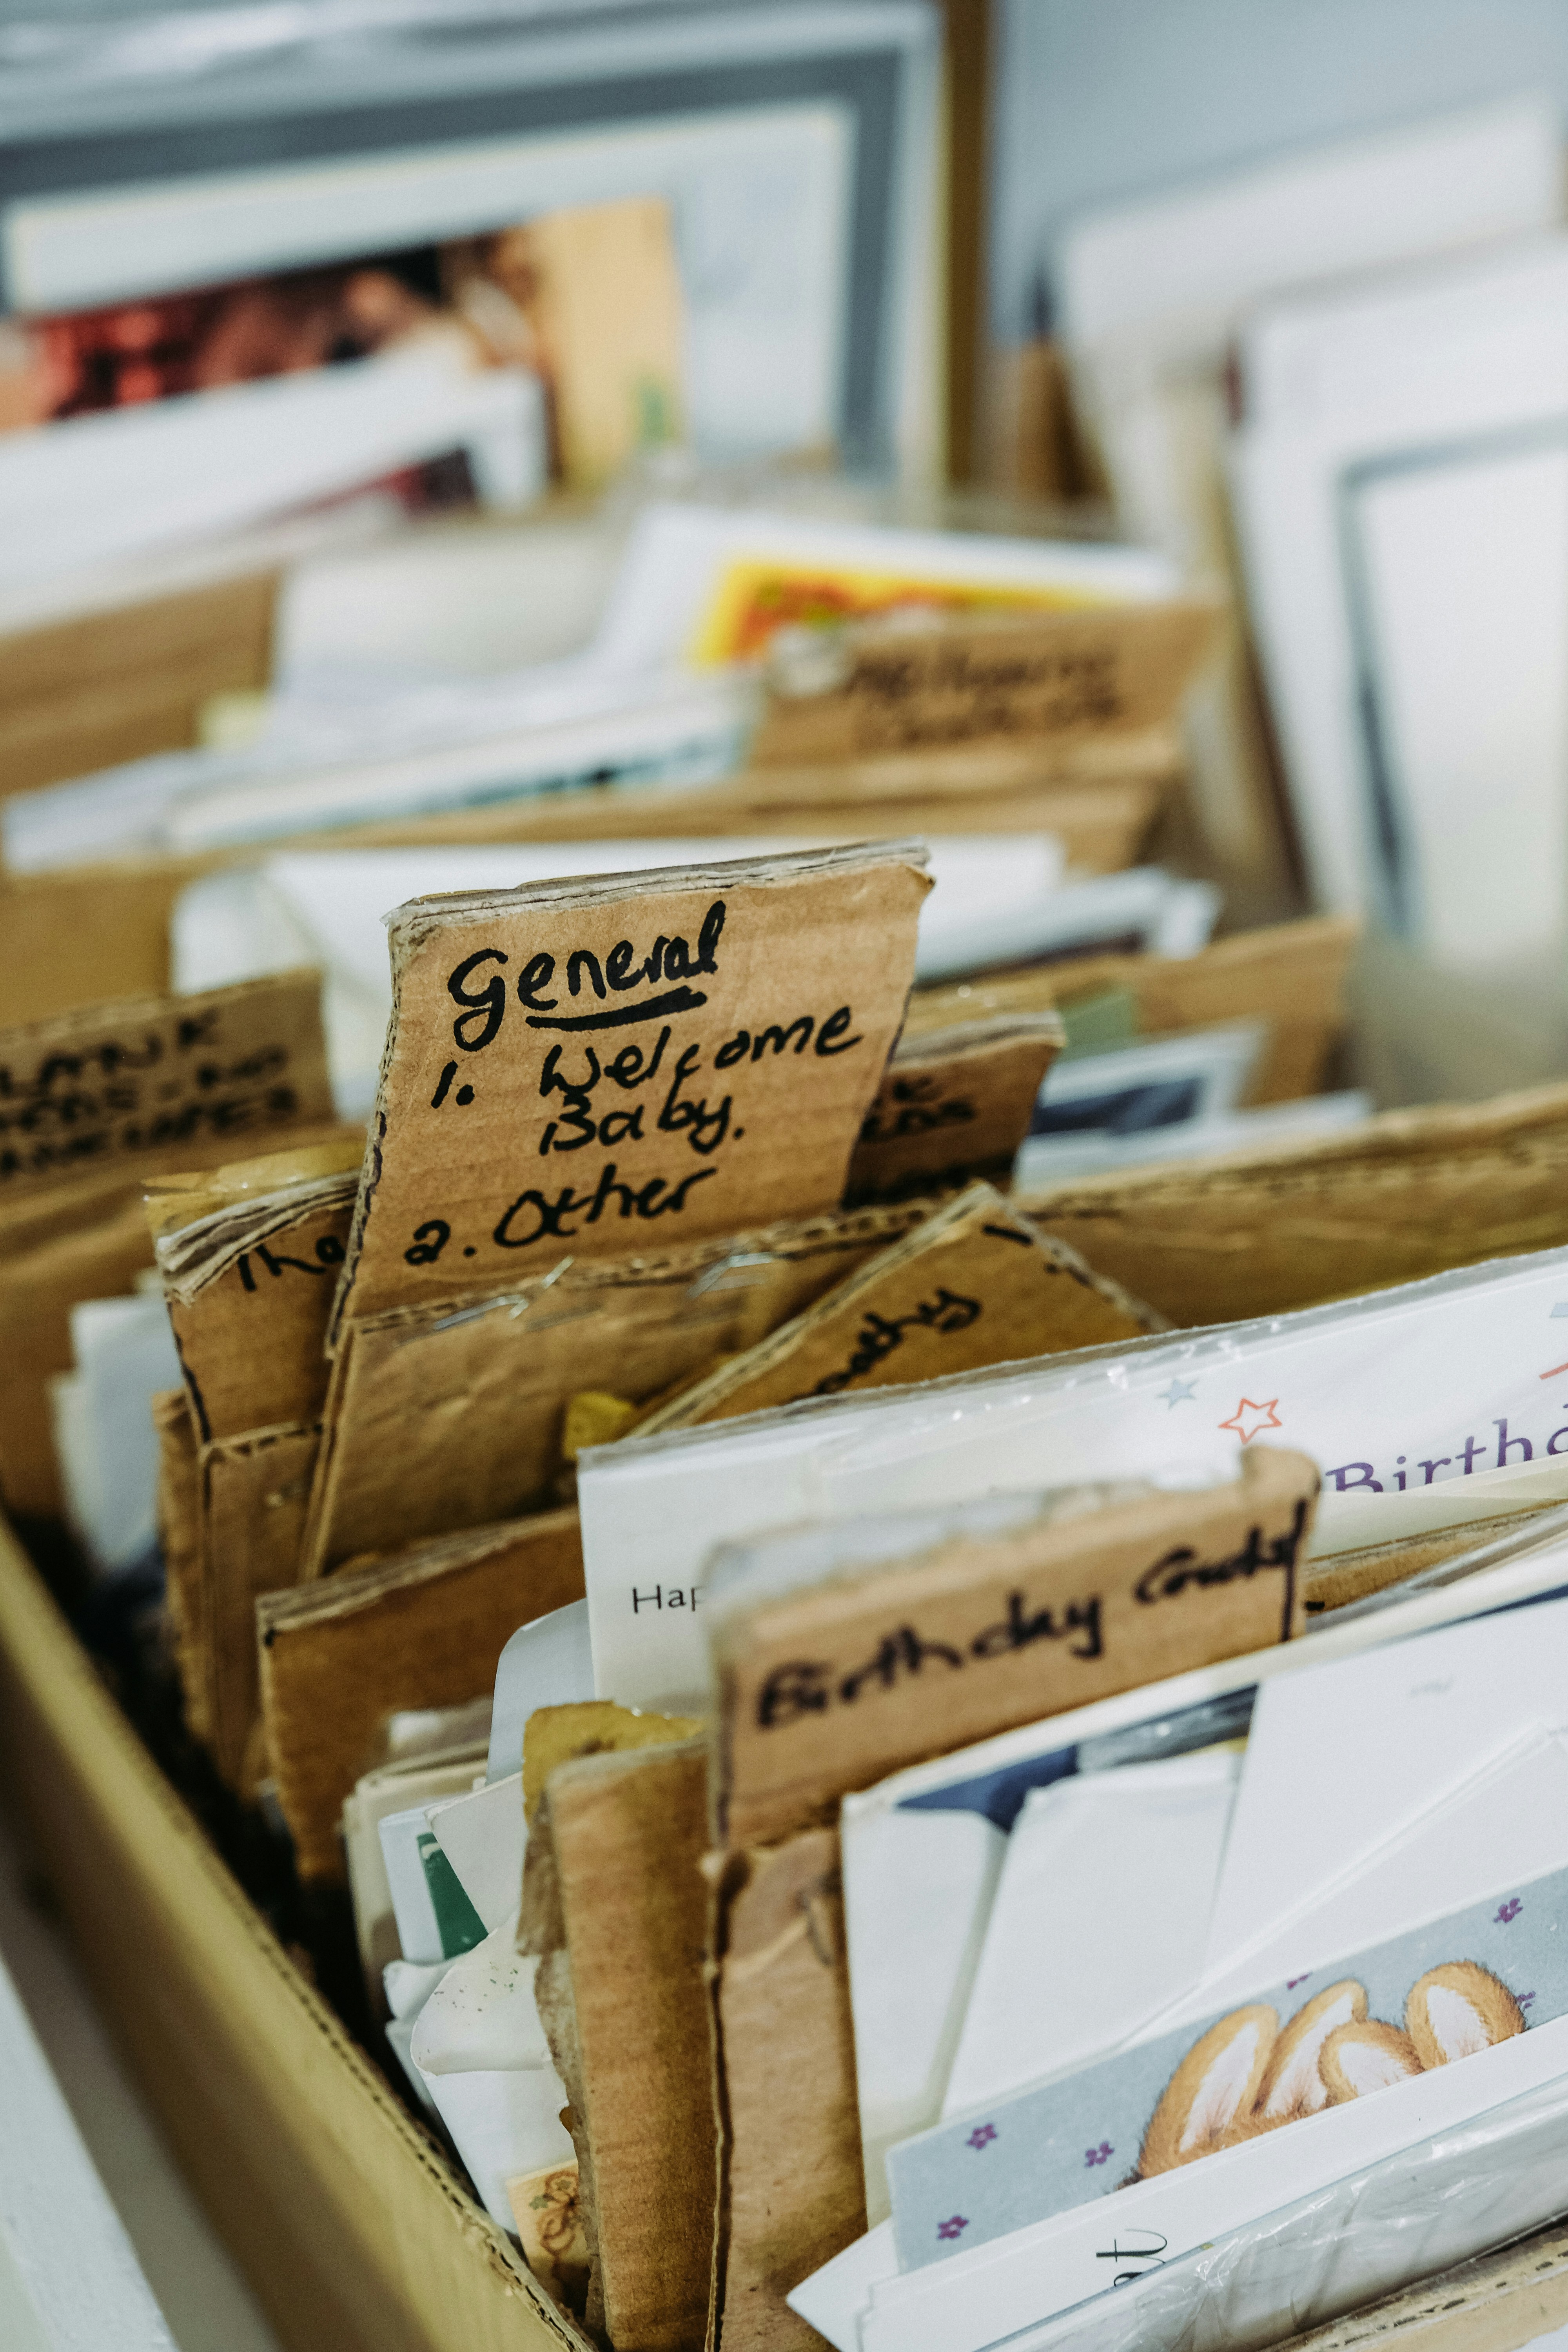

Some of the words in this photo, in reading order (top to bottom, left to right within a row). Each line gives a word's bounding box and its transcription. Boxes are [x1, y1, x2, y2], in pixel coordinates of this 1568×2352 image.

[447, 900, 727, 1052] General
[431, 1060, 475, 1109] 1.
[539, 1005, 864, 1097] Welcome
[539, 1073, 746, 1156] Baby.
[404, 1219, 477, 1266] 2.
[493, 1163, 718, 1249] Other
[757, 1586, 1105, 1731] Birthday
